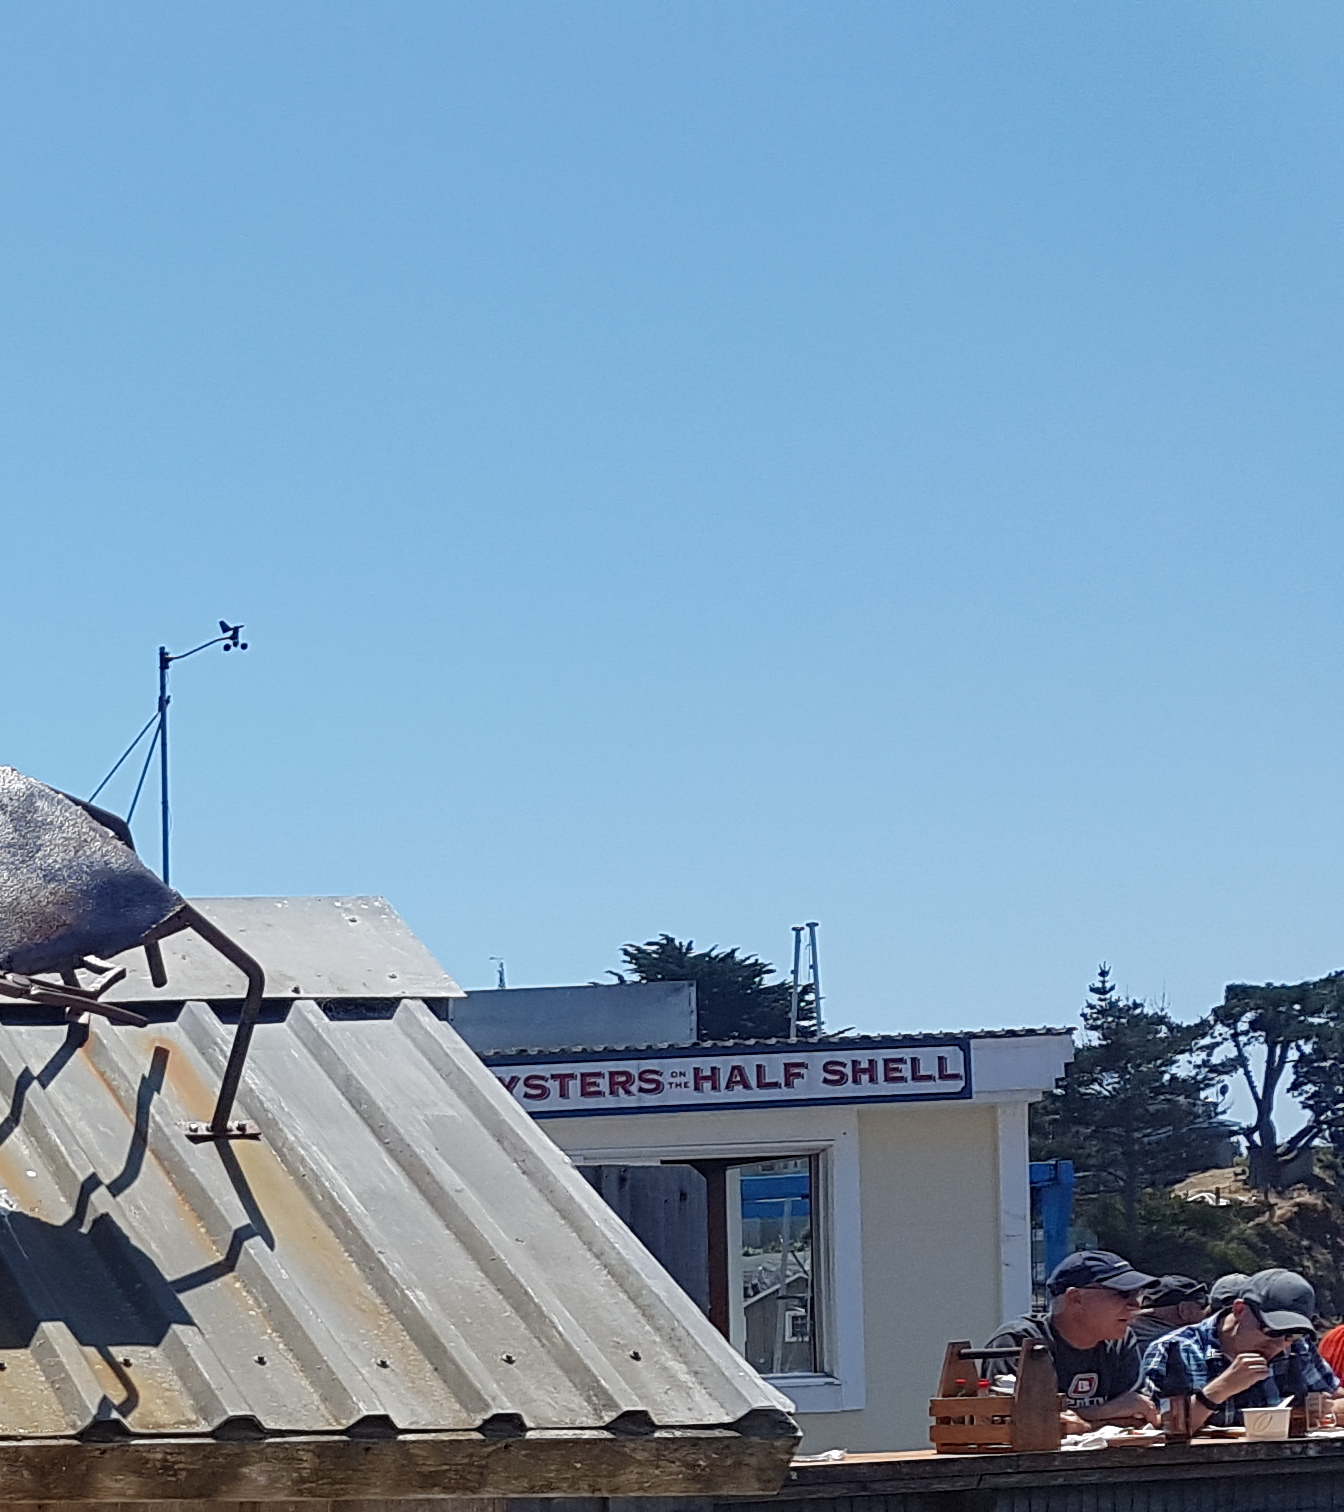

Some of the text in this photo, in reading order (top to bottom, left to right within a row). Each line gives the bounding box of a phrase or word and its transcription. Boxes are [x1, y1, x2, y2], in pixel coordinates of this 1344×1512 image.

[670, 1070, 686, 1079] ON
[693, 1061, 809, 1093] HALF
[823, 1055, 963, 1087] SHELL
[668, 1081, 690, 1090] THE
